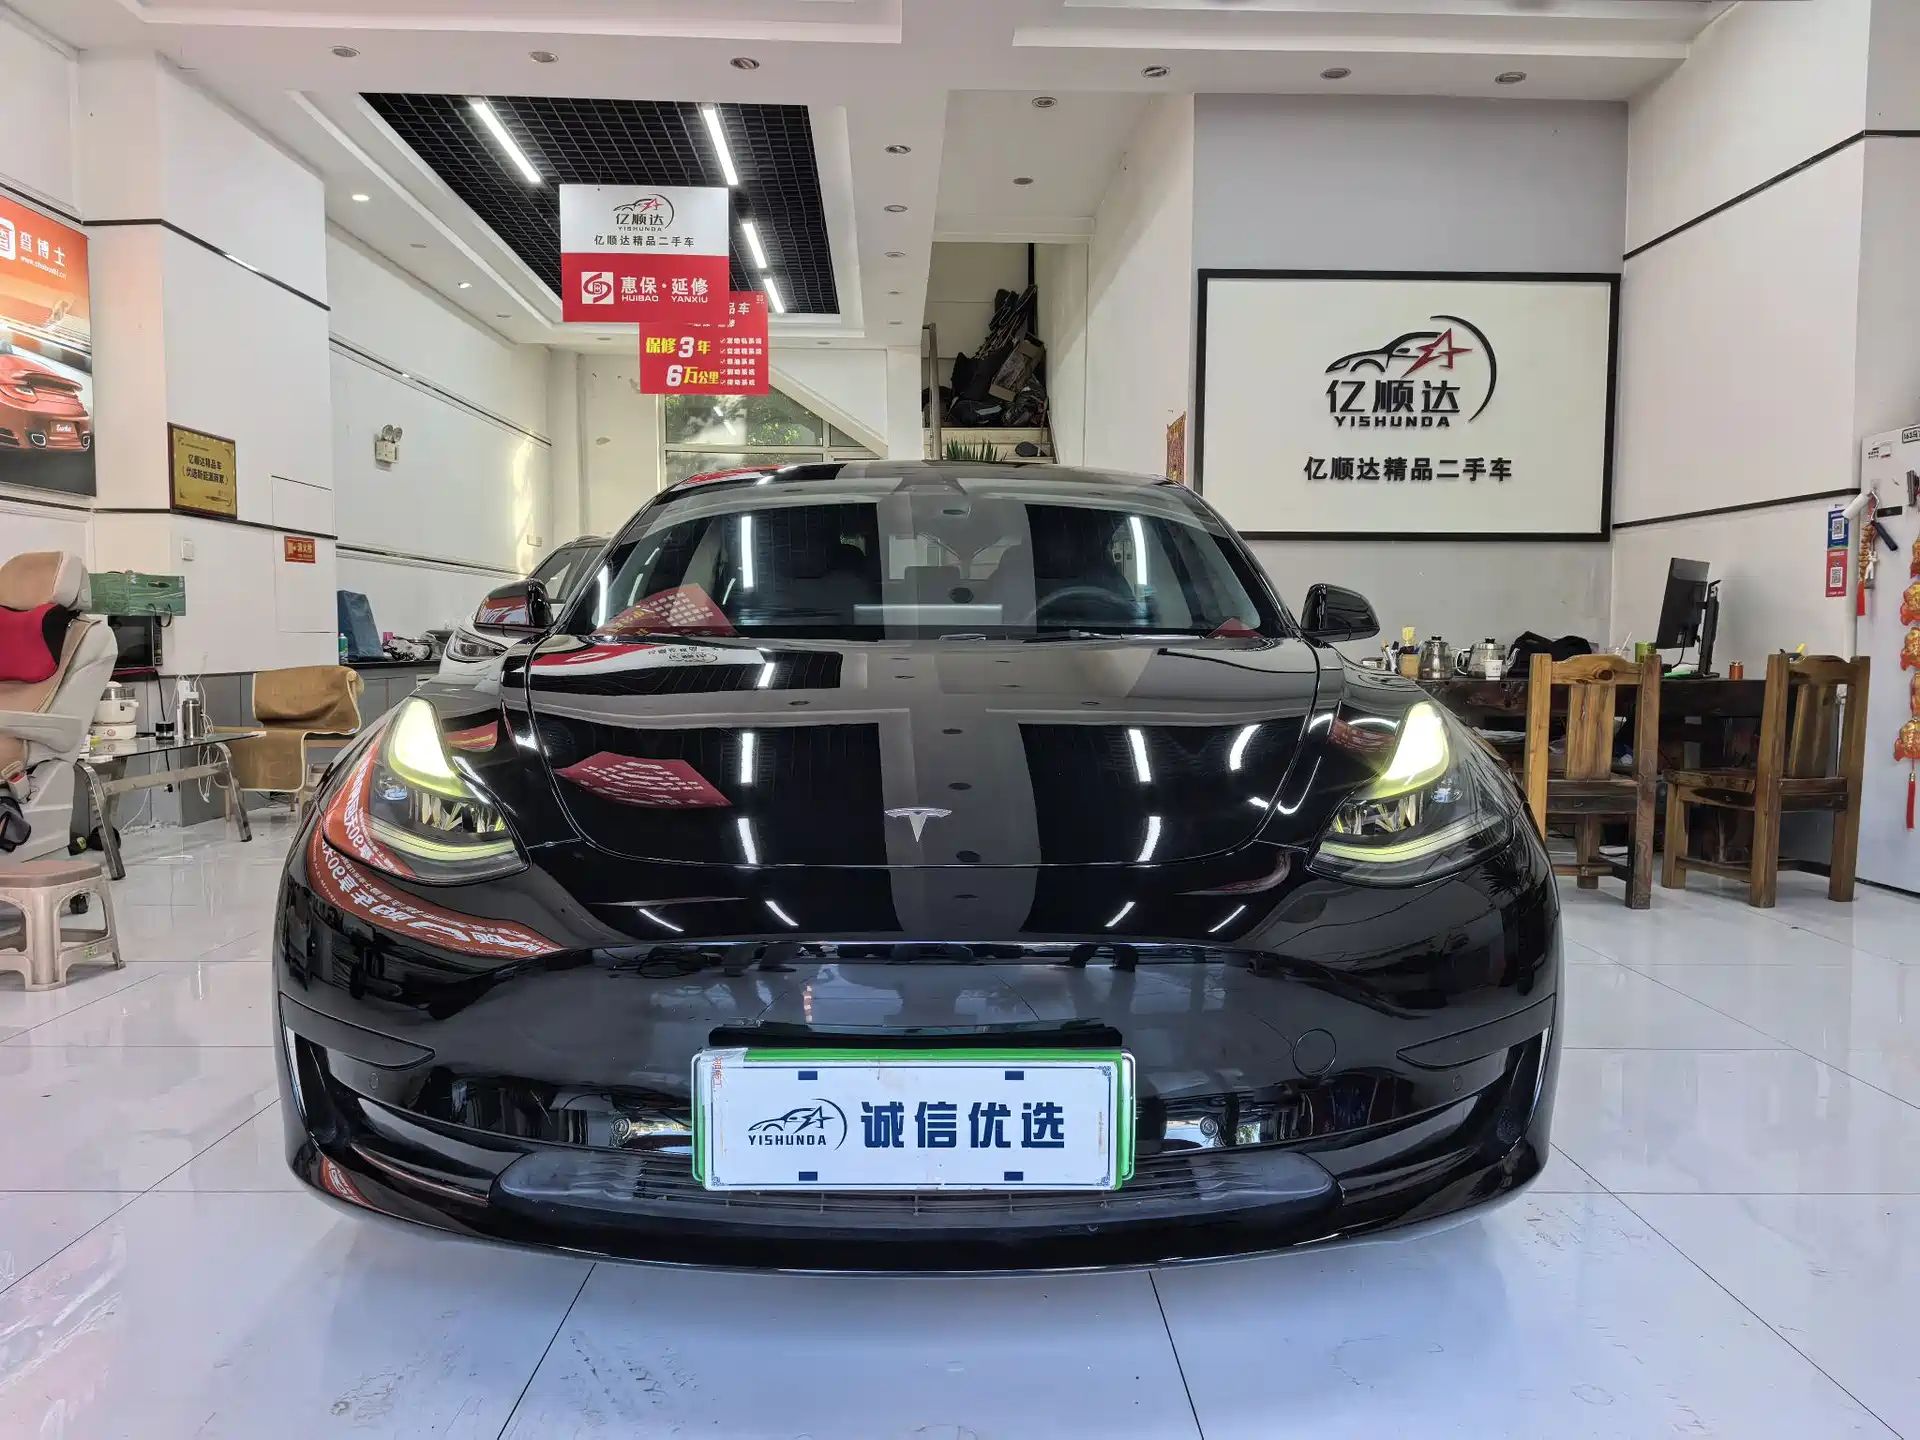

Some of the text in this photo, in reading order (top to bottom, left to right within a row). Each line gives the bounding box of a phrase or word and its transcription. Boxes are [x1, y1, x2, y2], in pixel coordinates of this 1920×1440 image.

[615, 213, 665, 226] 亿顺达
[19, 231, 66, 267] 查博士
[594, 235, 695, 247] 亿顺达精品二手车
[671, 295, 709, 304] YANXIU
[666, 364, 720, 387] 6万公里
[1325, 379, 1462, 414] 亿顺达
[1333, 415, 1451, 428] YISHUNDA
[187, 453, 223, 471] 亿顺达精品车
[1303, 456, 1513, 482] 亿顺达精品二手车
[861, 1101, 1065, 1149] 诚信优选
[748, 1134, 827, 1146] YISHUNDA
